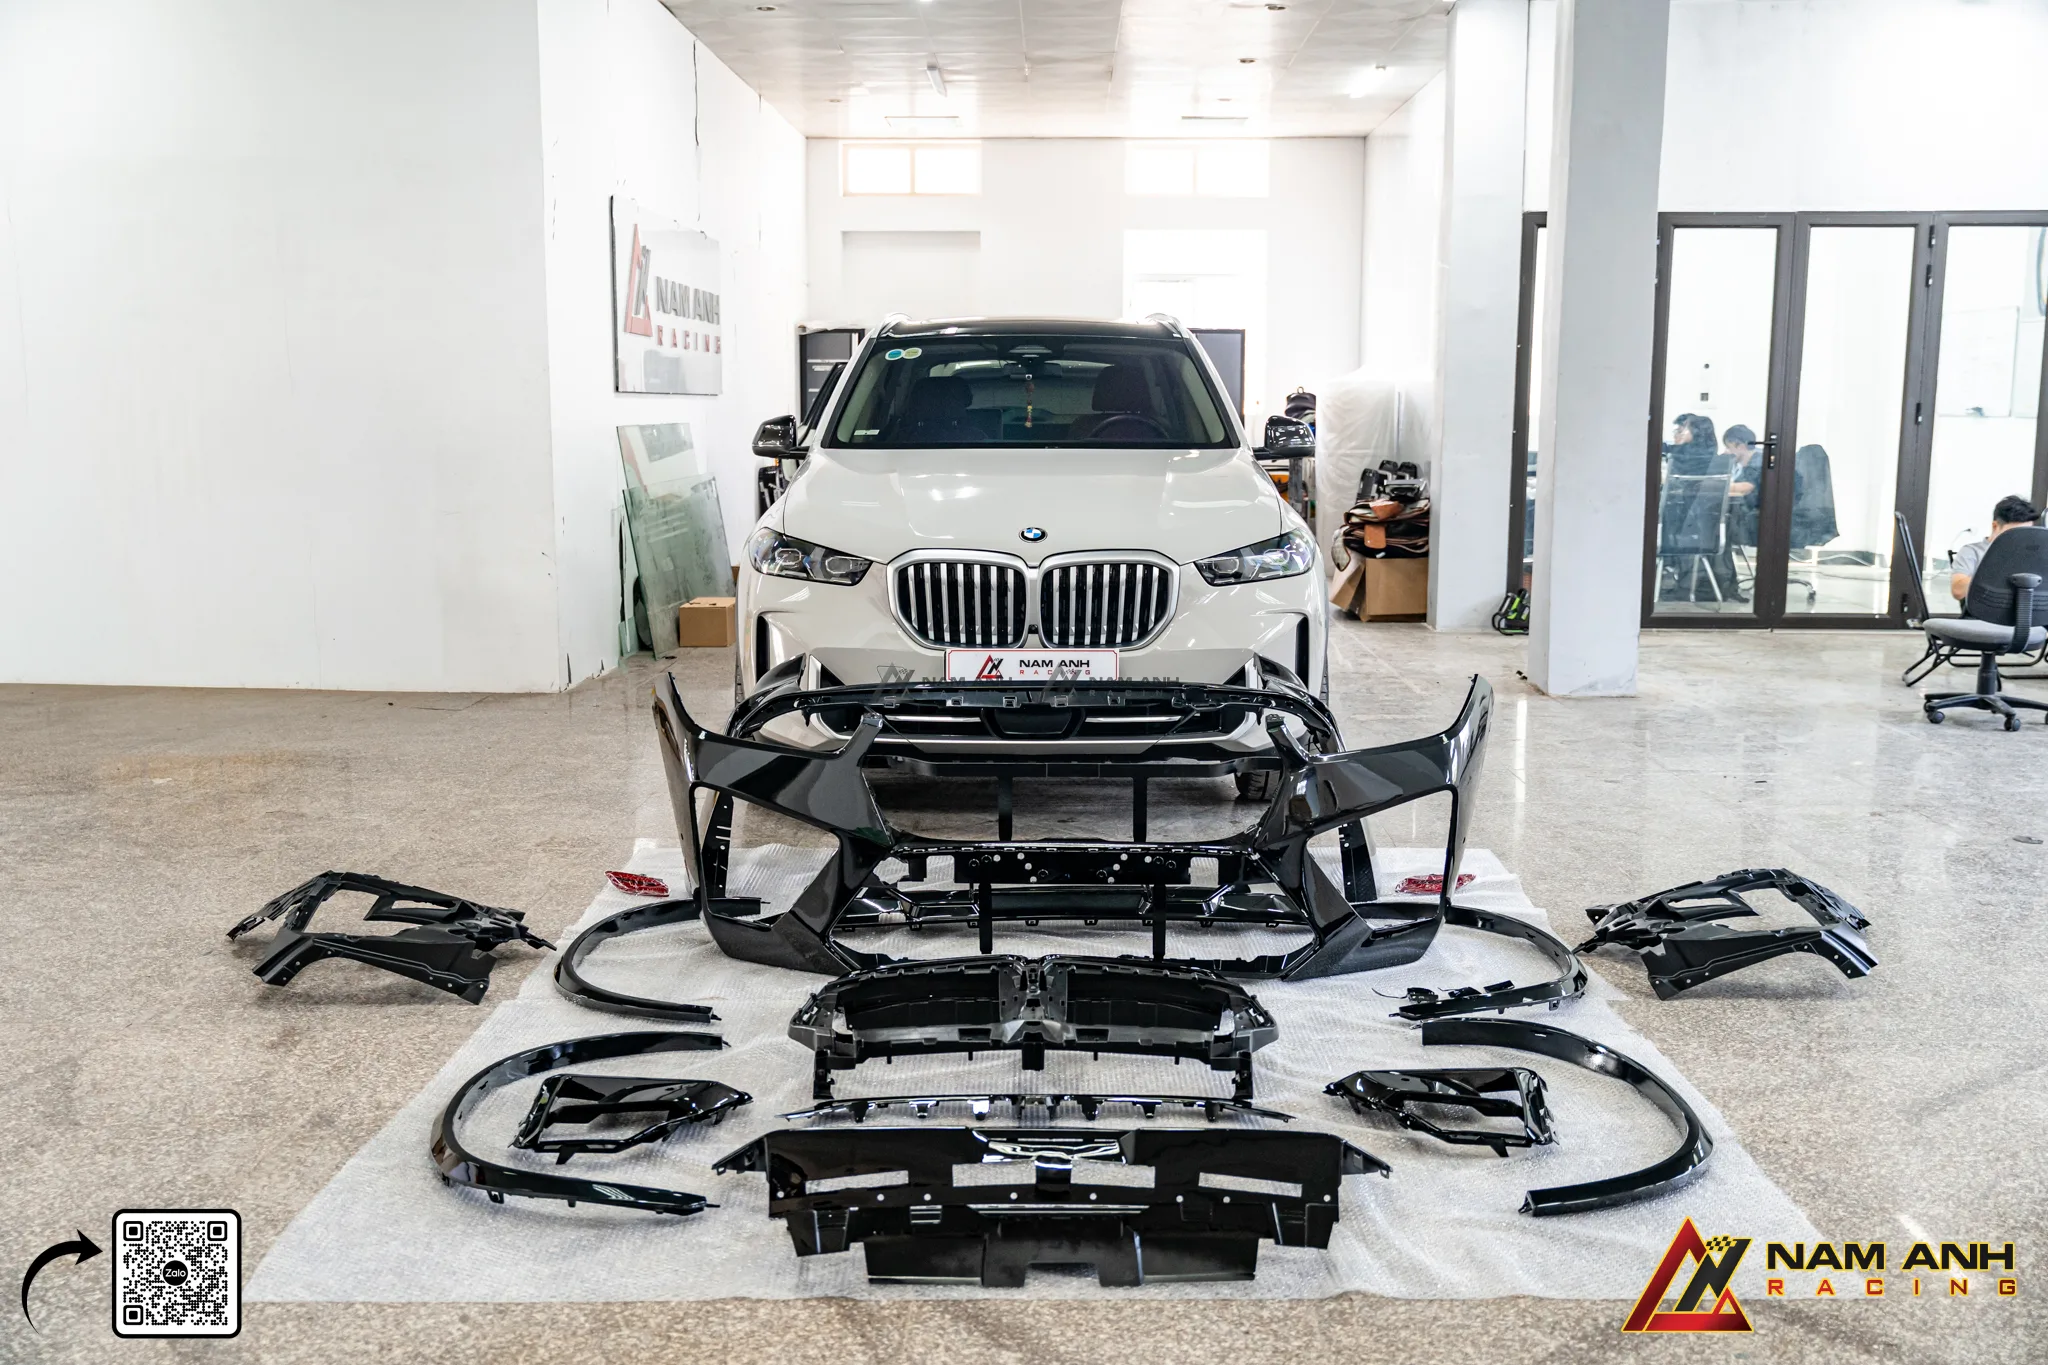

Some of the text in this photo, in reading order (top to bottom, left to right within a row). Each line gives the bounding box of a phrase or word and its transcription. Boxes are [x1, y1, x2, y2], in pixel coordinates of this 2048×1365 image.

[656, 276, 720, 326] NAM ANH
[657, 325, 721, 354] RACING
[1019, 659, 1090, 668] NAM ANH
